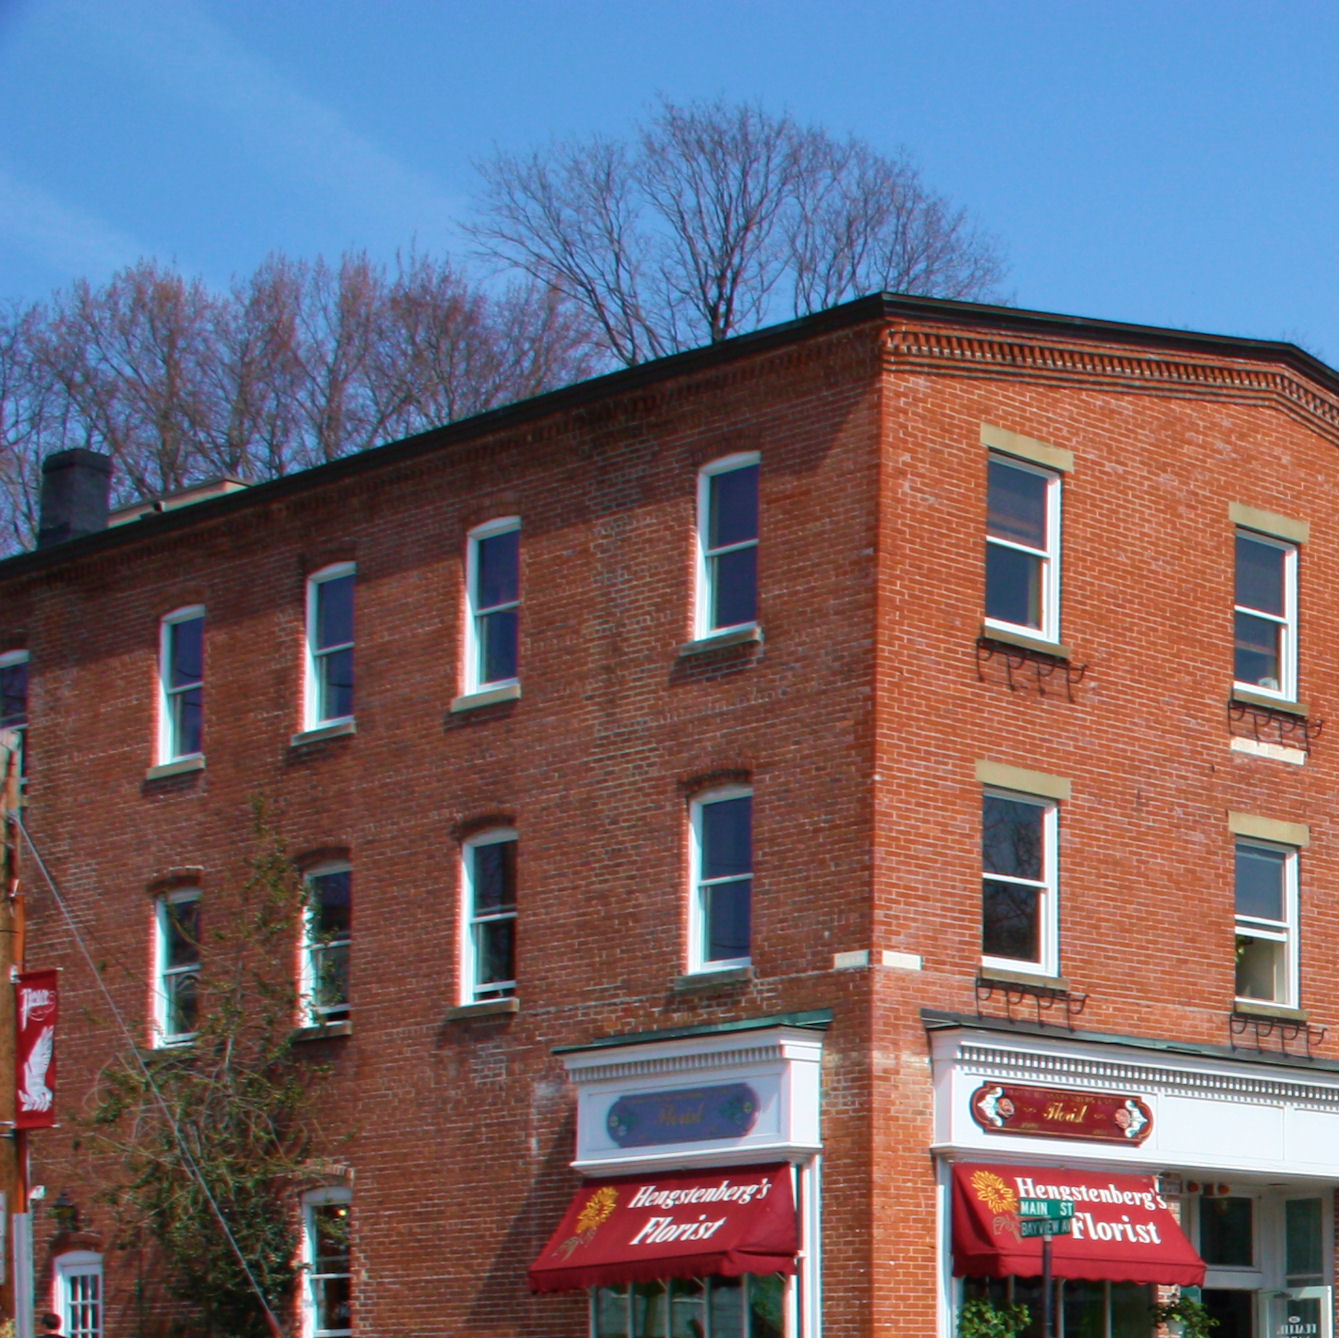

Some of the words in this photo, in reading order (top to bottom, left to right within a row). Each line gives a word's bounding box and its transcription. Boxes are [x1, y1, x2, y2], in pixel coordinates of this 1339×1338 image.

[627, 1178, 772, 1210] Hengstenberg's
[1014, 1177, 1168, 1211] Hengstenberg's
[1020, 1201, 1048, 1215] MAIN
[1060, 1202, 1073, 1216] ST
[629, 1214, 727, 1245] Florist
[1021, 1219, 1060, 1236] BAYVIEW
[1072, 1211, 1161, 1244] Florist
